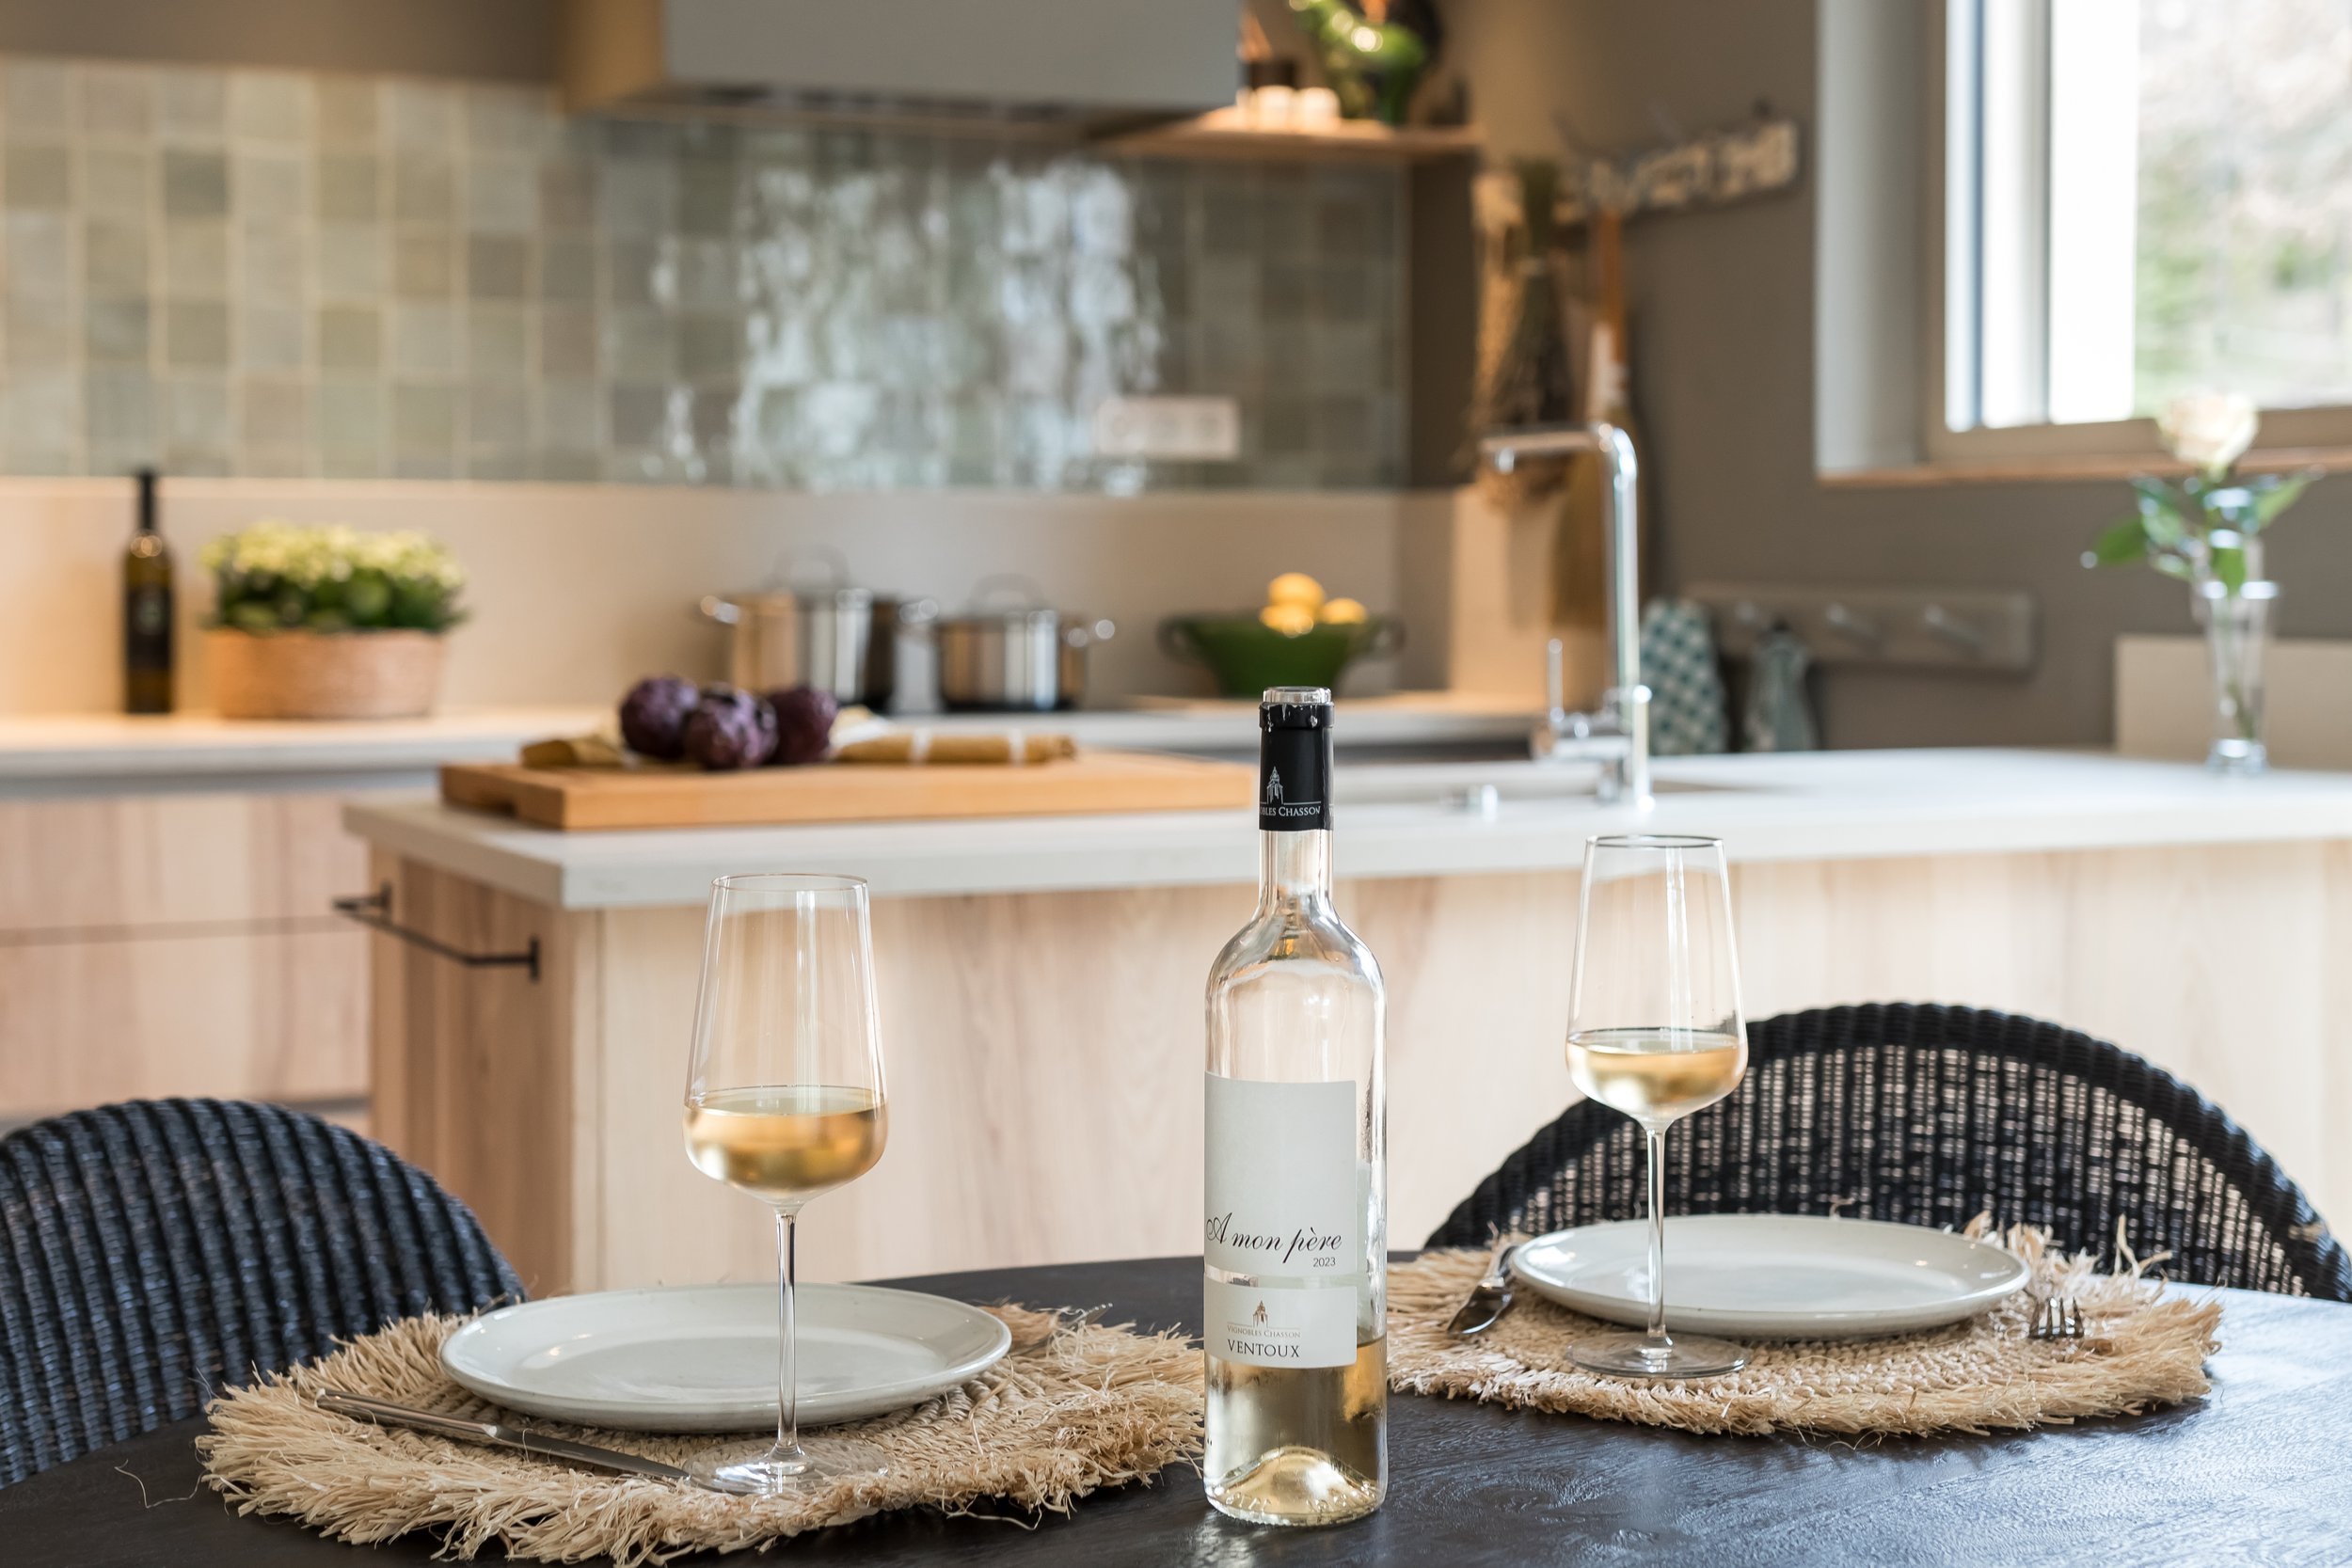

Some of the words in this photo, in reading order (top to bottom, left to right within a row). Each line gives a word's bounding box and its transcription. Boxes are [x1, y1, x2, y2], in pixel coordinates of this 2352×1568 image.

[1206, 1212, 1232, 1244] A
[1232, 1231, 1283, 1250] mon
[1282, 1226, 1343, 1264] père
[1312, 1257, 1336, 1268] 2023
[1227, 1338, 1300, 1358] VENTOUX
